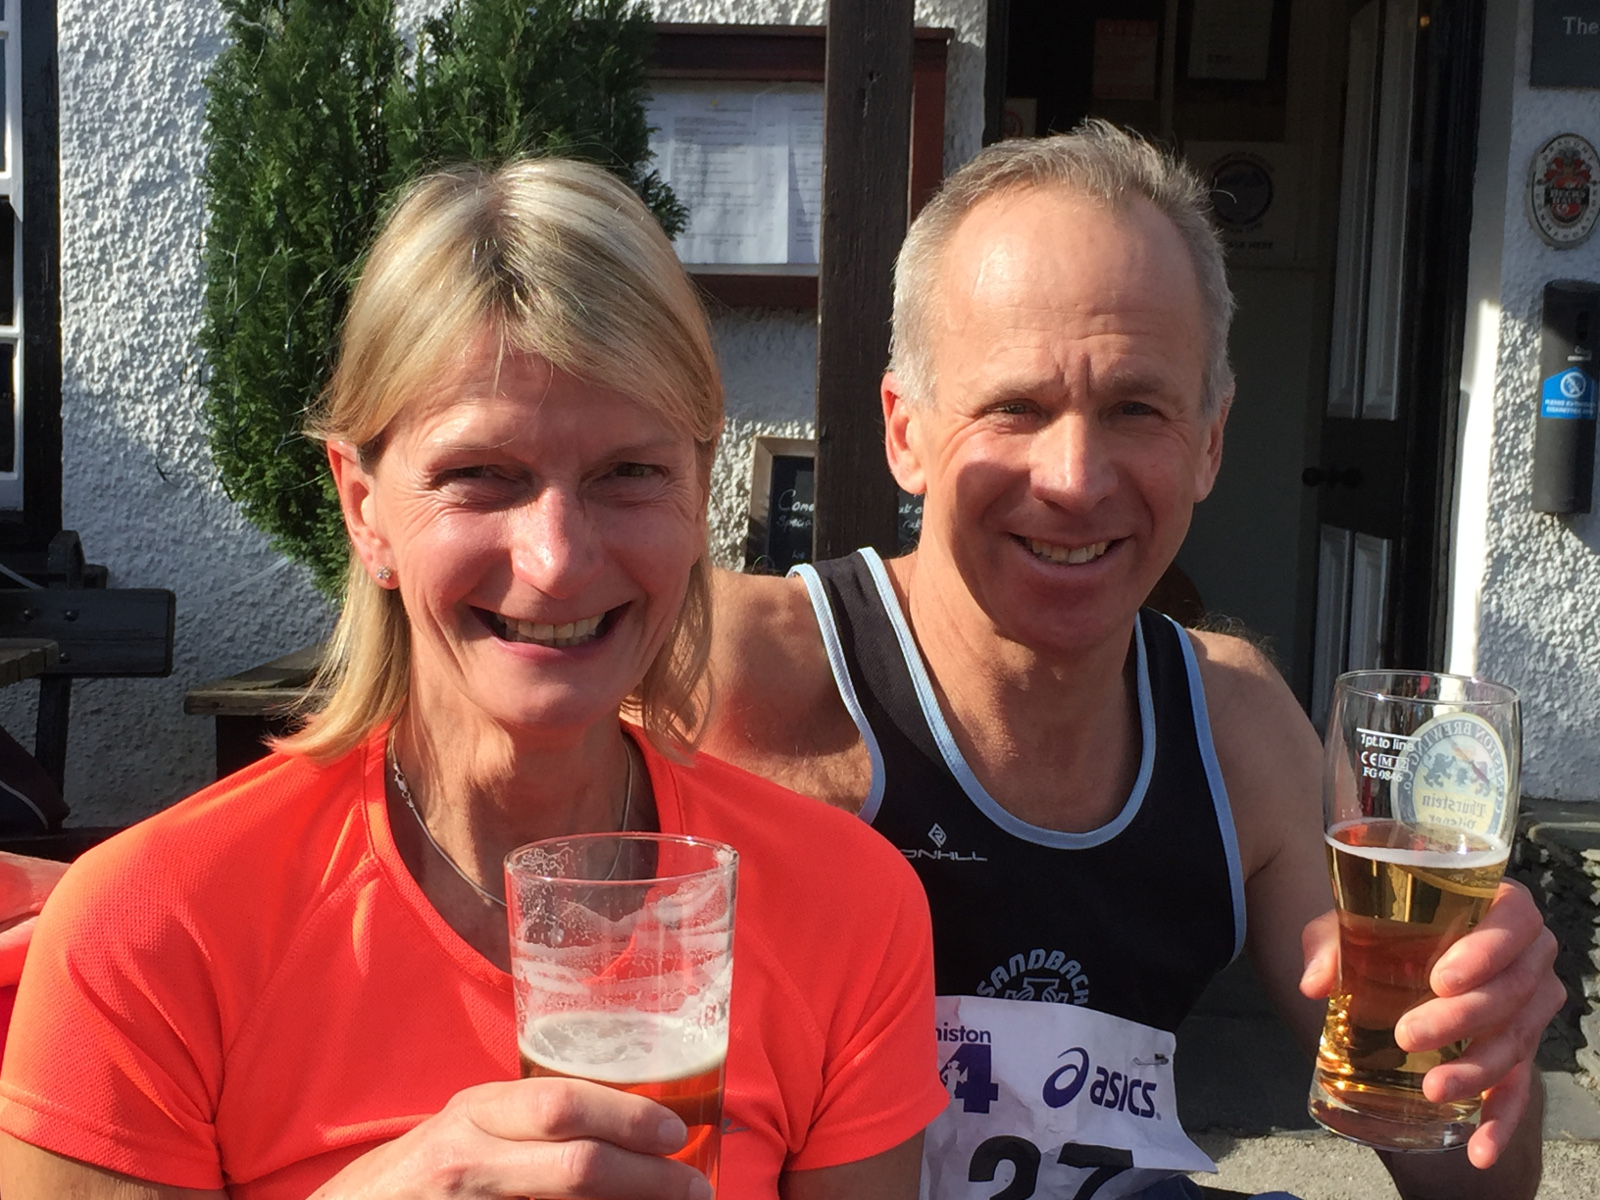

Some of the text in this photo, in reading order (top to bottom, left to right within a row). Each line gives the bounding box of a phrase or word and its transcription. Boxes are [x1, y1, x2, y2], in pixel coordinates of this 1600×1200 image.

[1562, 16, 1600, 35] The
[776, 515, 813, 533] Specia
[899, 848, 988, 861] ONHILL
[976, 948, 1090, 1005] SANDBACH
[935, 1022, 992, 1044] niston
[940, 1043, 999, 1114] 4
[1089, 1066, 1157, 1119] asics
